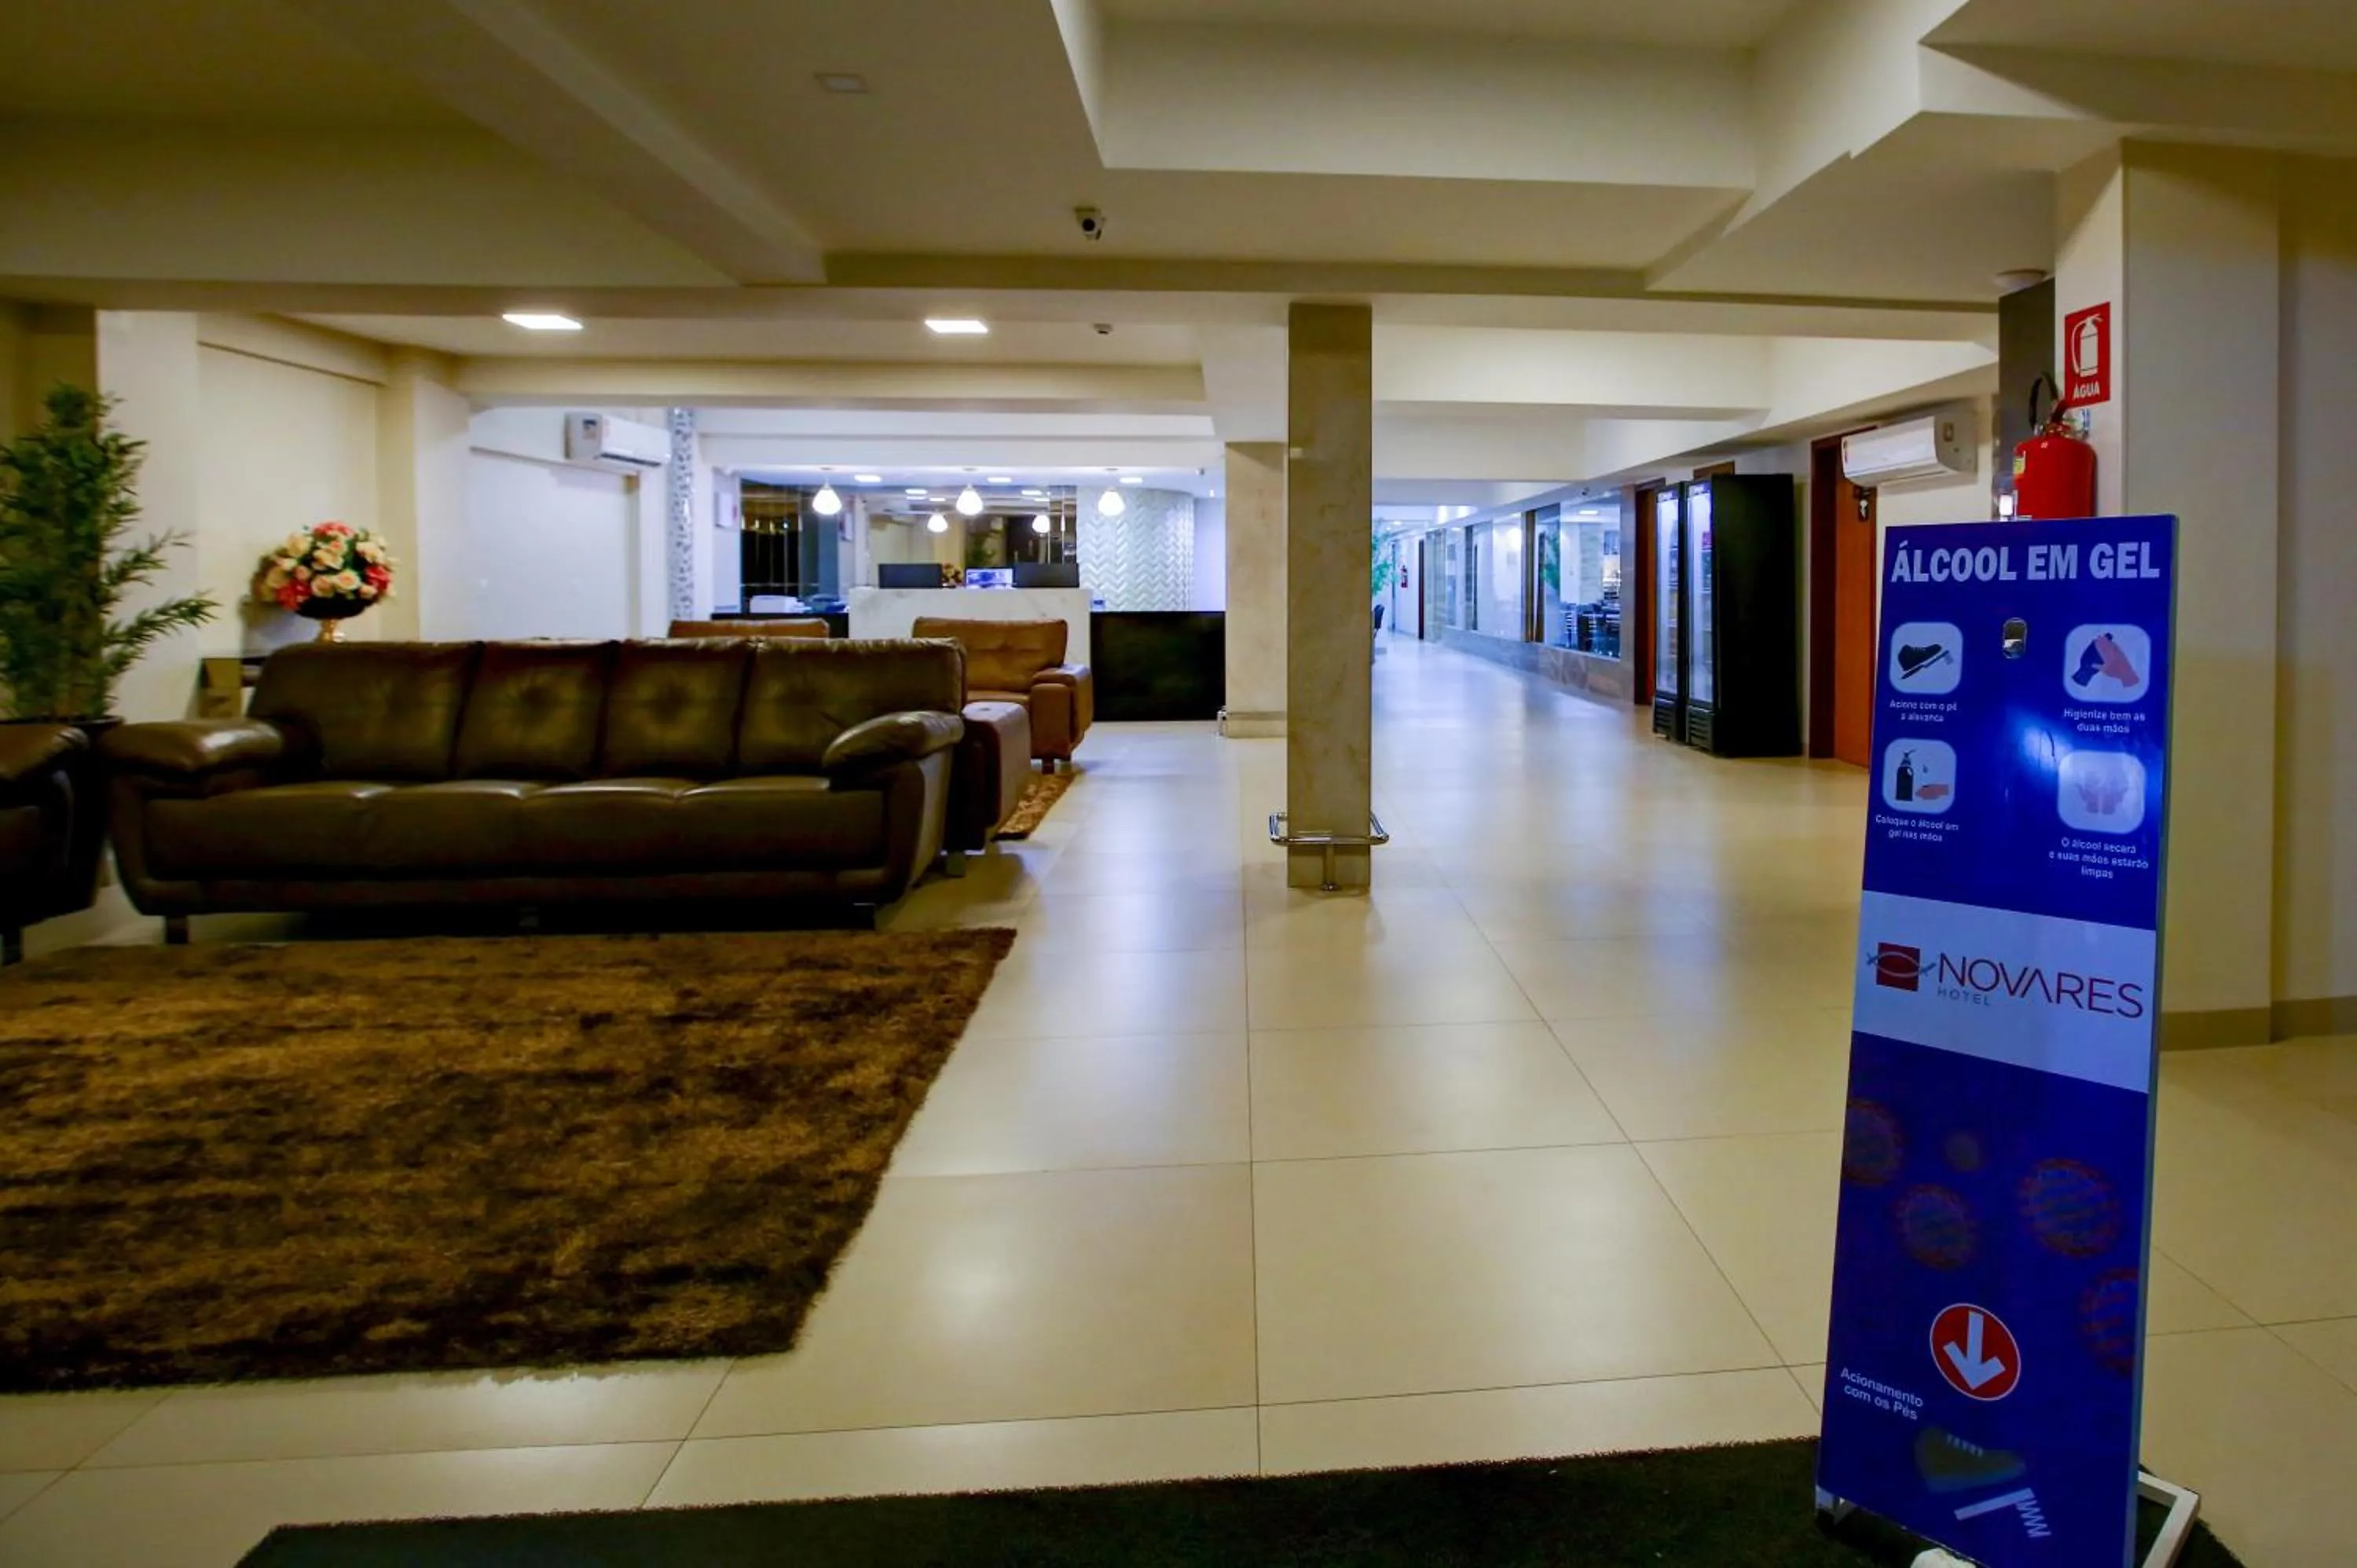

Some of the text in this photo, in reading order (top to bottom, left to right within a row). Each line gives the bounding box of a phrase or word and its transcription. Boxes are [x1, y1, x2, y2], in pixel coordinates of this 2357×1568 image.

[1891, 540, 2160, 582] ÁLCOOL EM GEL
[2063, 707, 2146, 721] Higienize bem as
[2077, 722, 2130, 733] duas mãos
[2061, 836, 2070, 848] O
[2072, 838, 2102, 850] álcool
[2058, 852, 2080, 862] suas
[2081, 865, 2113, 879] limpas
[1937, 952, 2143, 1018] NOVARES
[1937, 986, 1991, 1007] HOTEL
[1840, 1367, 1923, 1407] Acionamento
[1844, 1385, 1918, 1420] com os Pés
